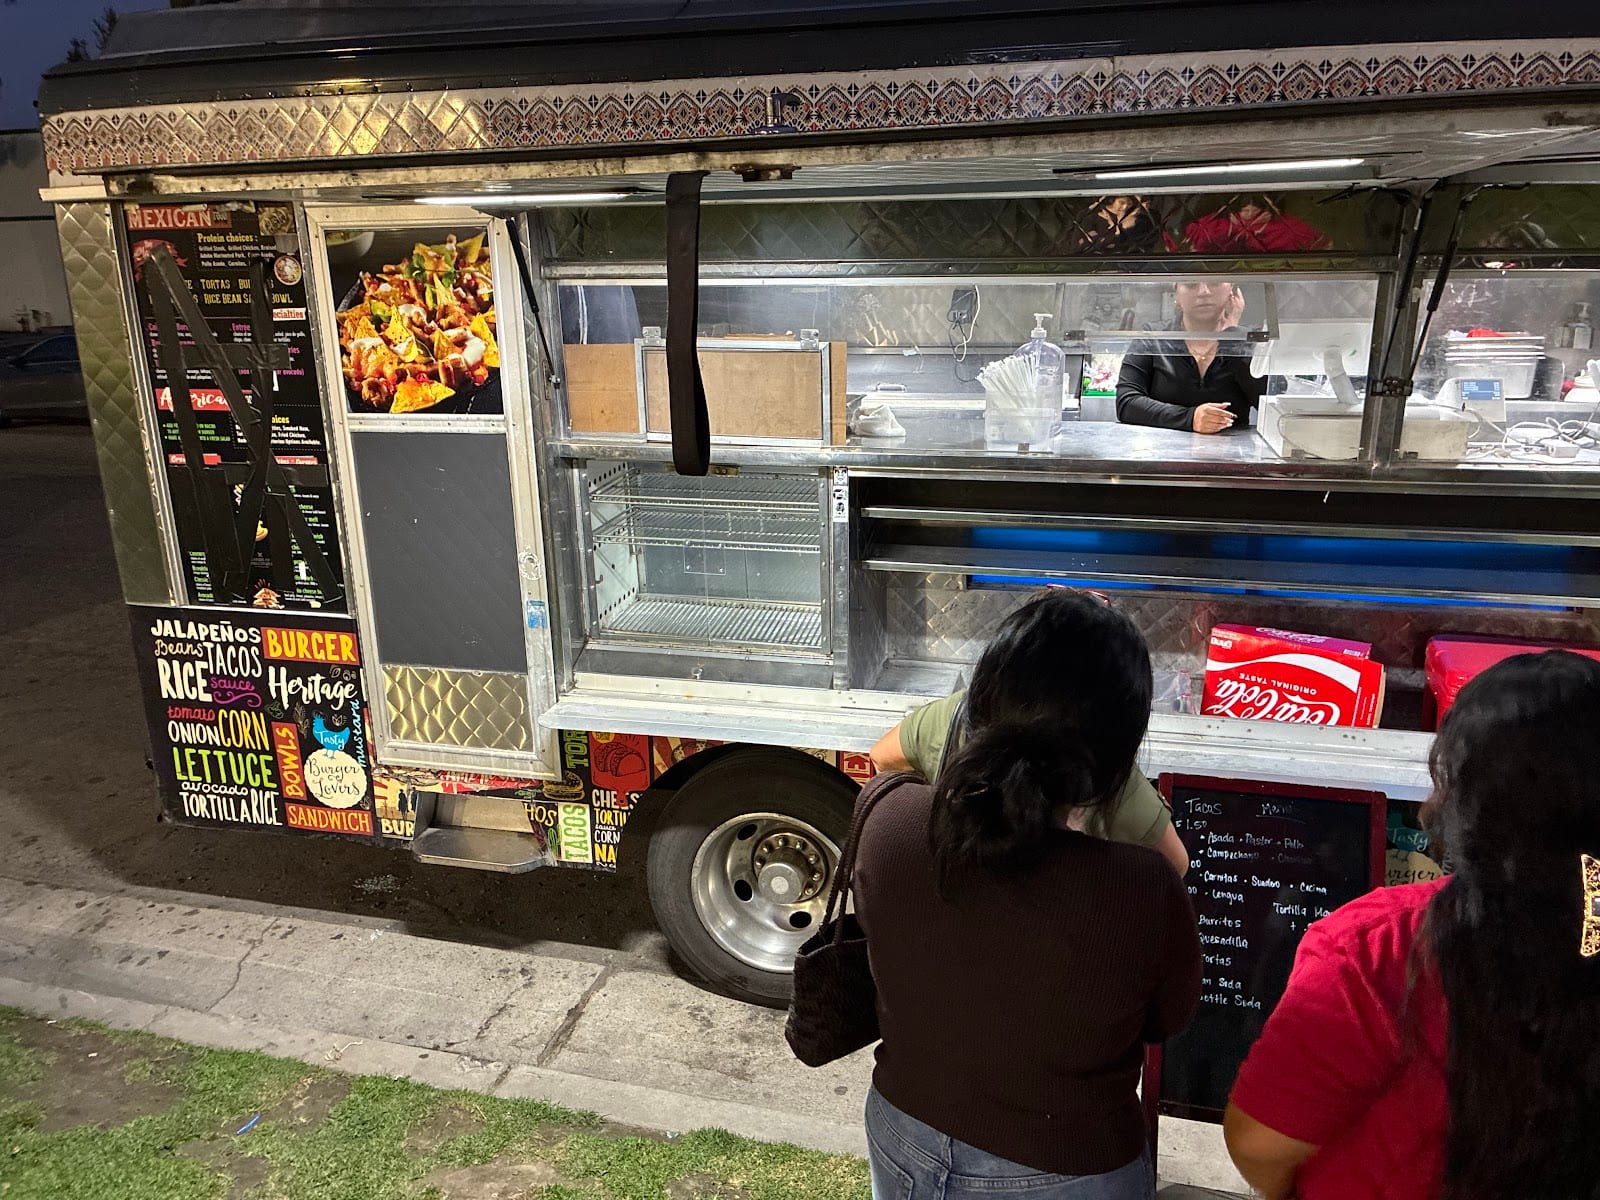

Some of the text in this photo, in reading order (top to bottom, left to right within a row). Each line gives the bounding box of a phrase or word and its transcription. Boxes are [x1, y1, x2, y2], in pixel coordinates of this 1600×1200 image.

[127, 209, 212, 228] MEXICAN
[197, 232, 225, 243] Protein
[201, 279, 230, 290] TORTAS
[204, 293, 221, 304] RICE
[222, 293, 242, 304] BEAN
[273, 309, 304, 318] ecialties
[272, 415, 290, 424] oices
[150, 619, 261, 644] JALAPEÑOS
[266, 629, 357, 662] BURGER
[154, 640, 262, 678] Beans TACOS
[157, 658, 213, 702] RICE
[210, 676, 256, 691] sauce
[268, 665, 358, 710] Heritage
[1239, 672, 1317, 695] ORIGINAL TASTE
[167, 705, 270, 751] tomato CORN
[168, 720, 221, 747] ONION
[350, 699, 367, 767] mustard
[314, 731, 345, 750] Tasty
[172, 746, 278, 788] LETTUCE
[276, 727, 304, 797] BOWLS
[307, 758, 360, 783] Burger
[181, 781, 249, 796] avocado
[312, 778, 360, 799] Lovers
[179, 789, 283, 826] TORTILLA RICE
[1185, 797, 1223, 815] Tacos
[287, 805, 371, 833] SANDWICH
[563, 804, 589, 859] TACOS
[595, 830, 620, 844] CORN
[1207, 831, 1235, 844] Asada
[1203, 870, 1238, 883] Carnitas
[1212, 888, 1245, 906] Lengua
[1272, 901, 1307, 917] Tortilla
[1198, 913, 1242, 928] Burritos
[1198, 932, 1249, 949] Quesadilla
[1218, 977, 1242, 990] Soda
[1200, 993, 1261, 1010] ottle Soda
